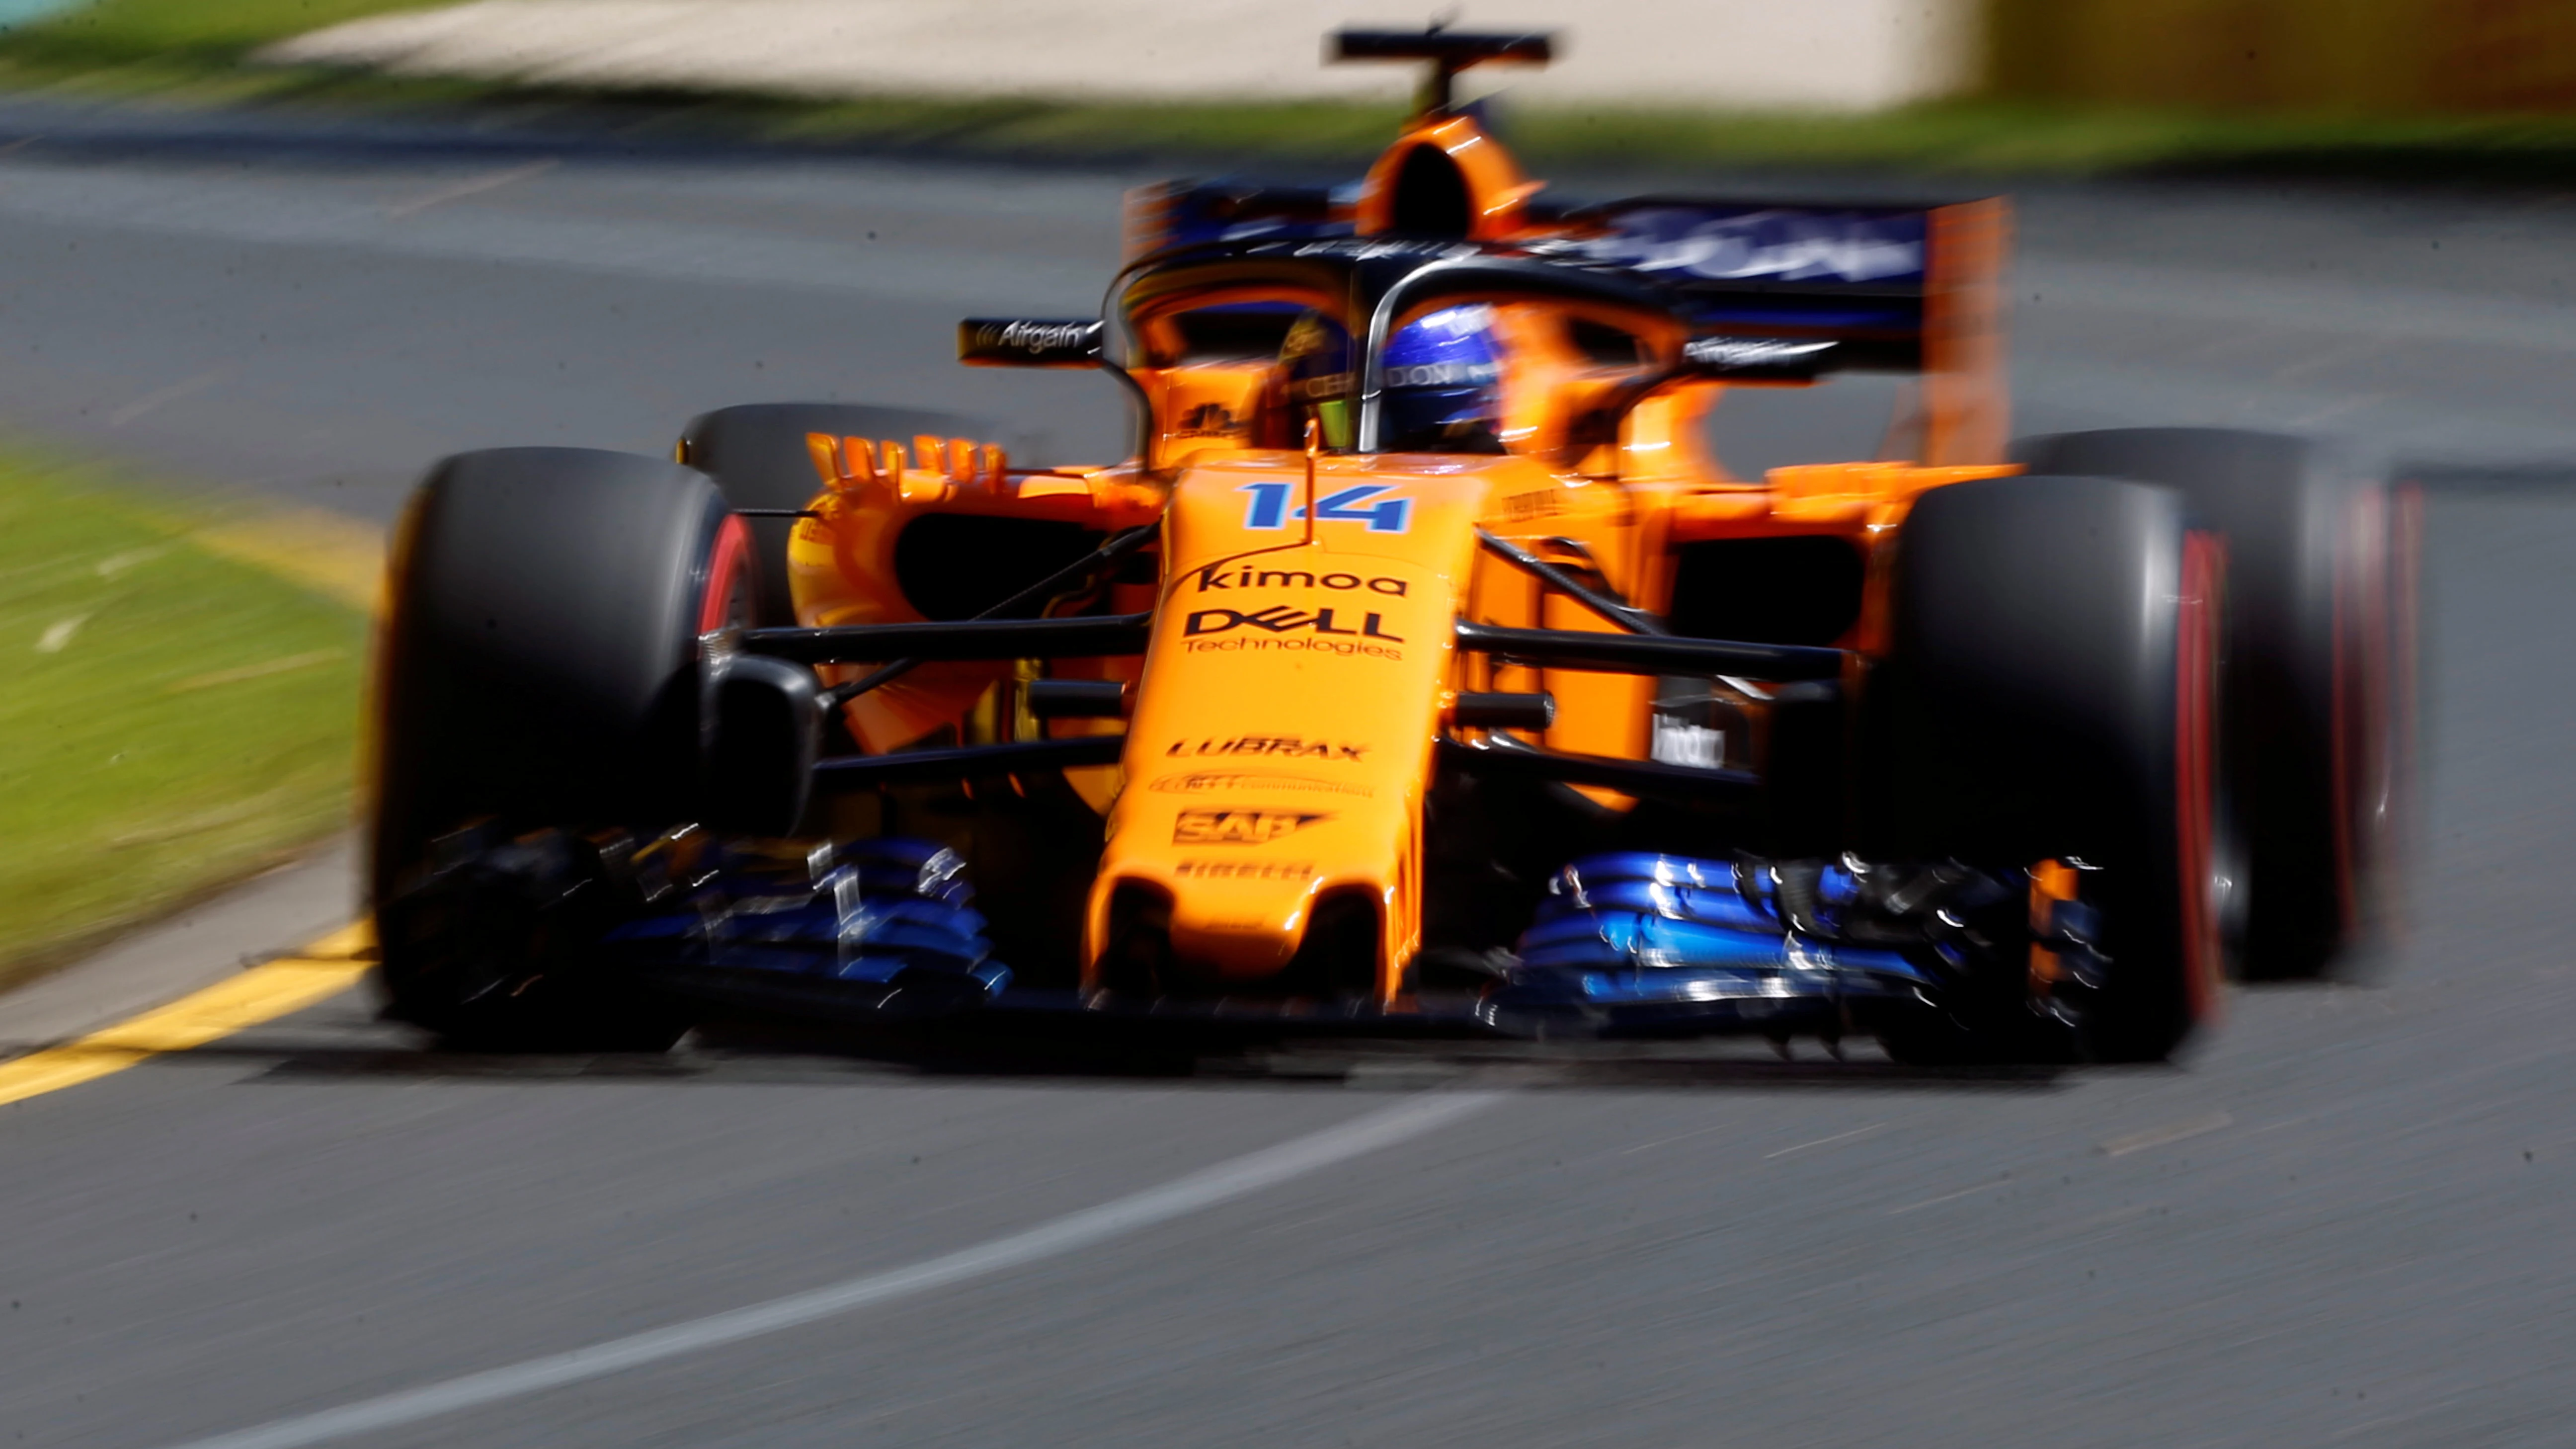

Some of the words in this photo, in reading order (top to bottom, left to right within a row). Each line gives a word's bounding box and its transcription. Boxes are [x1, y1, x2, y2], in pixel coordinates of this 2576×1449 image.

[1234, 482, 1414, 534] 14
[1197, 564, 1408, 597] kimoa
[1183, 606, 1405, 643] DELL
[1180, 637, 1403, 661] Technologies
[1166, 736, 1371, 762] LUBRAX
[1175, 811, 1299, 844] SAP
[1174, 861, 1315, 881] PIRELLI
